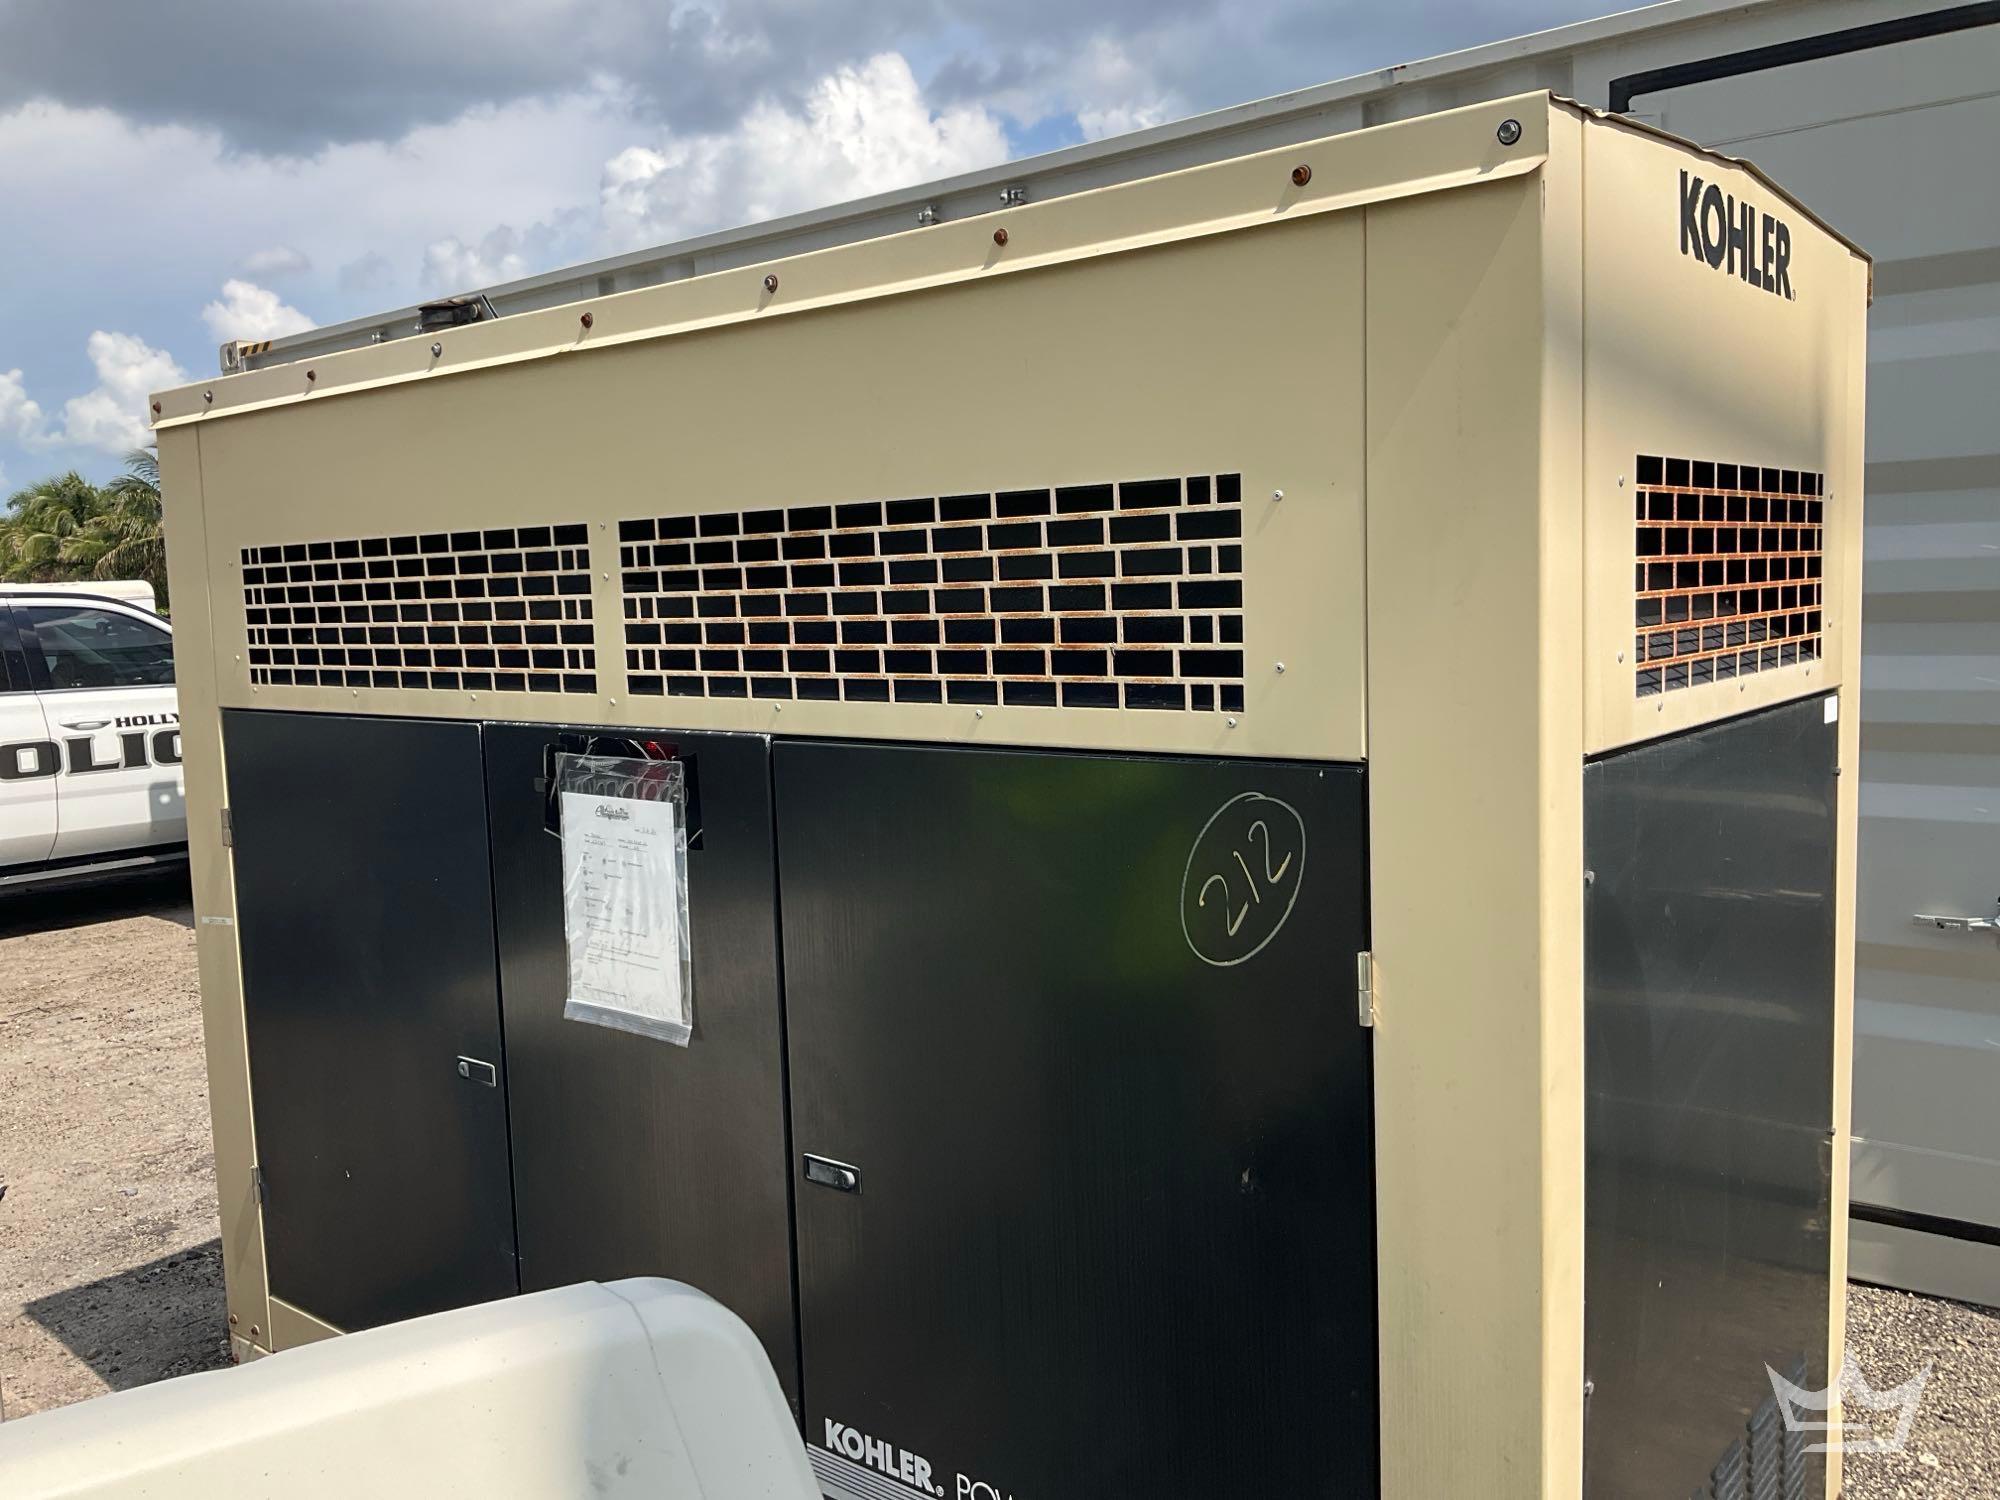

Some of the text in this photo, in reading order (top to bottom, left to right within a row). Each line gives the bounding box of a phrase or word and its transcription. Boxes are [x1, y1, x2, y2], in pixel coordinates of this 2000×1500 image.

[1680, 168, 1792, 301] KOHLER
[1199, 820, 1292, 937] 212
[825, 1417, 935, 1494] KOHLER
